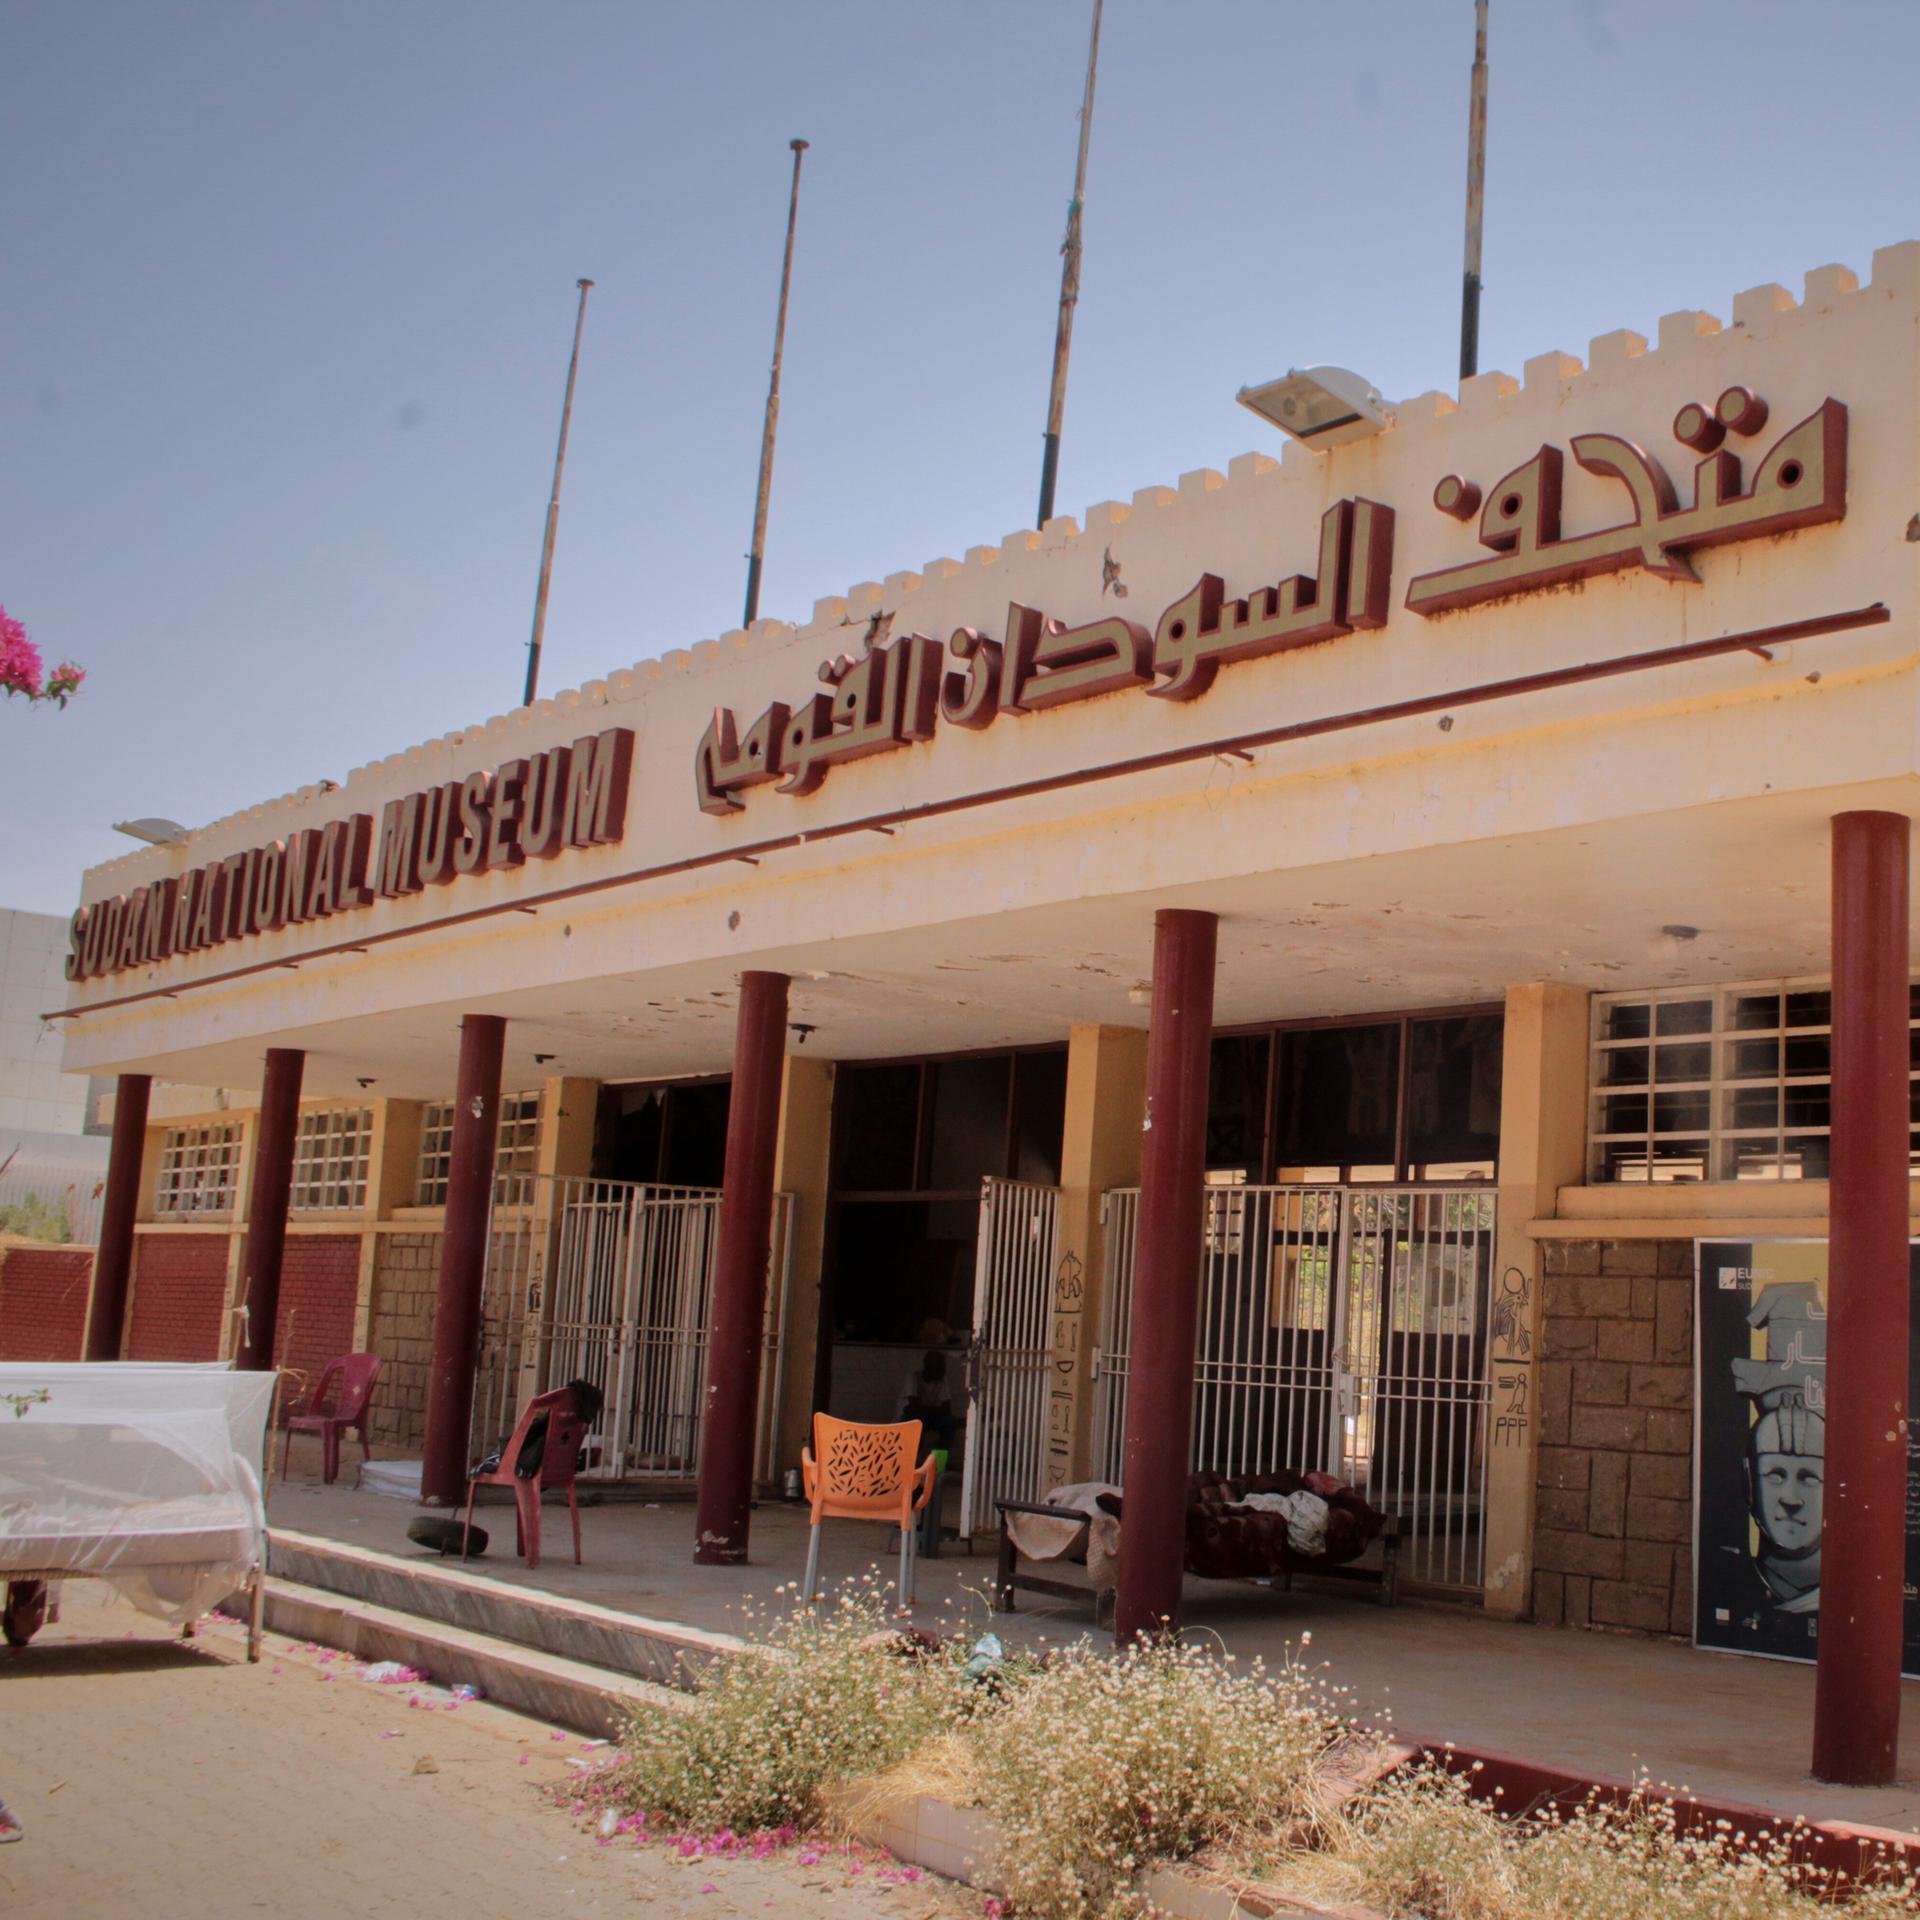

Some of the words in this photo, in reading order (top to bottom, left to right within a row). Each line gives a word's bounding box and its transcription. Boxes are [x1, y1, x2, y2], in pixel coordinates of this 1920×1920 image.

[942, 496, 1396, 731] السودان
[1404, 384, 1848, 617] متحف
[65, 878, 178, 982] SUDAN
[169, 813, 375, 954] NATIONAL
[374, 727, 636, 898] MUSEUM
